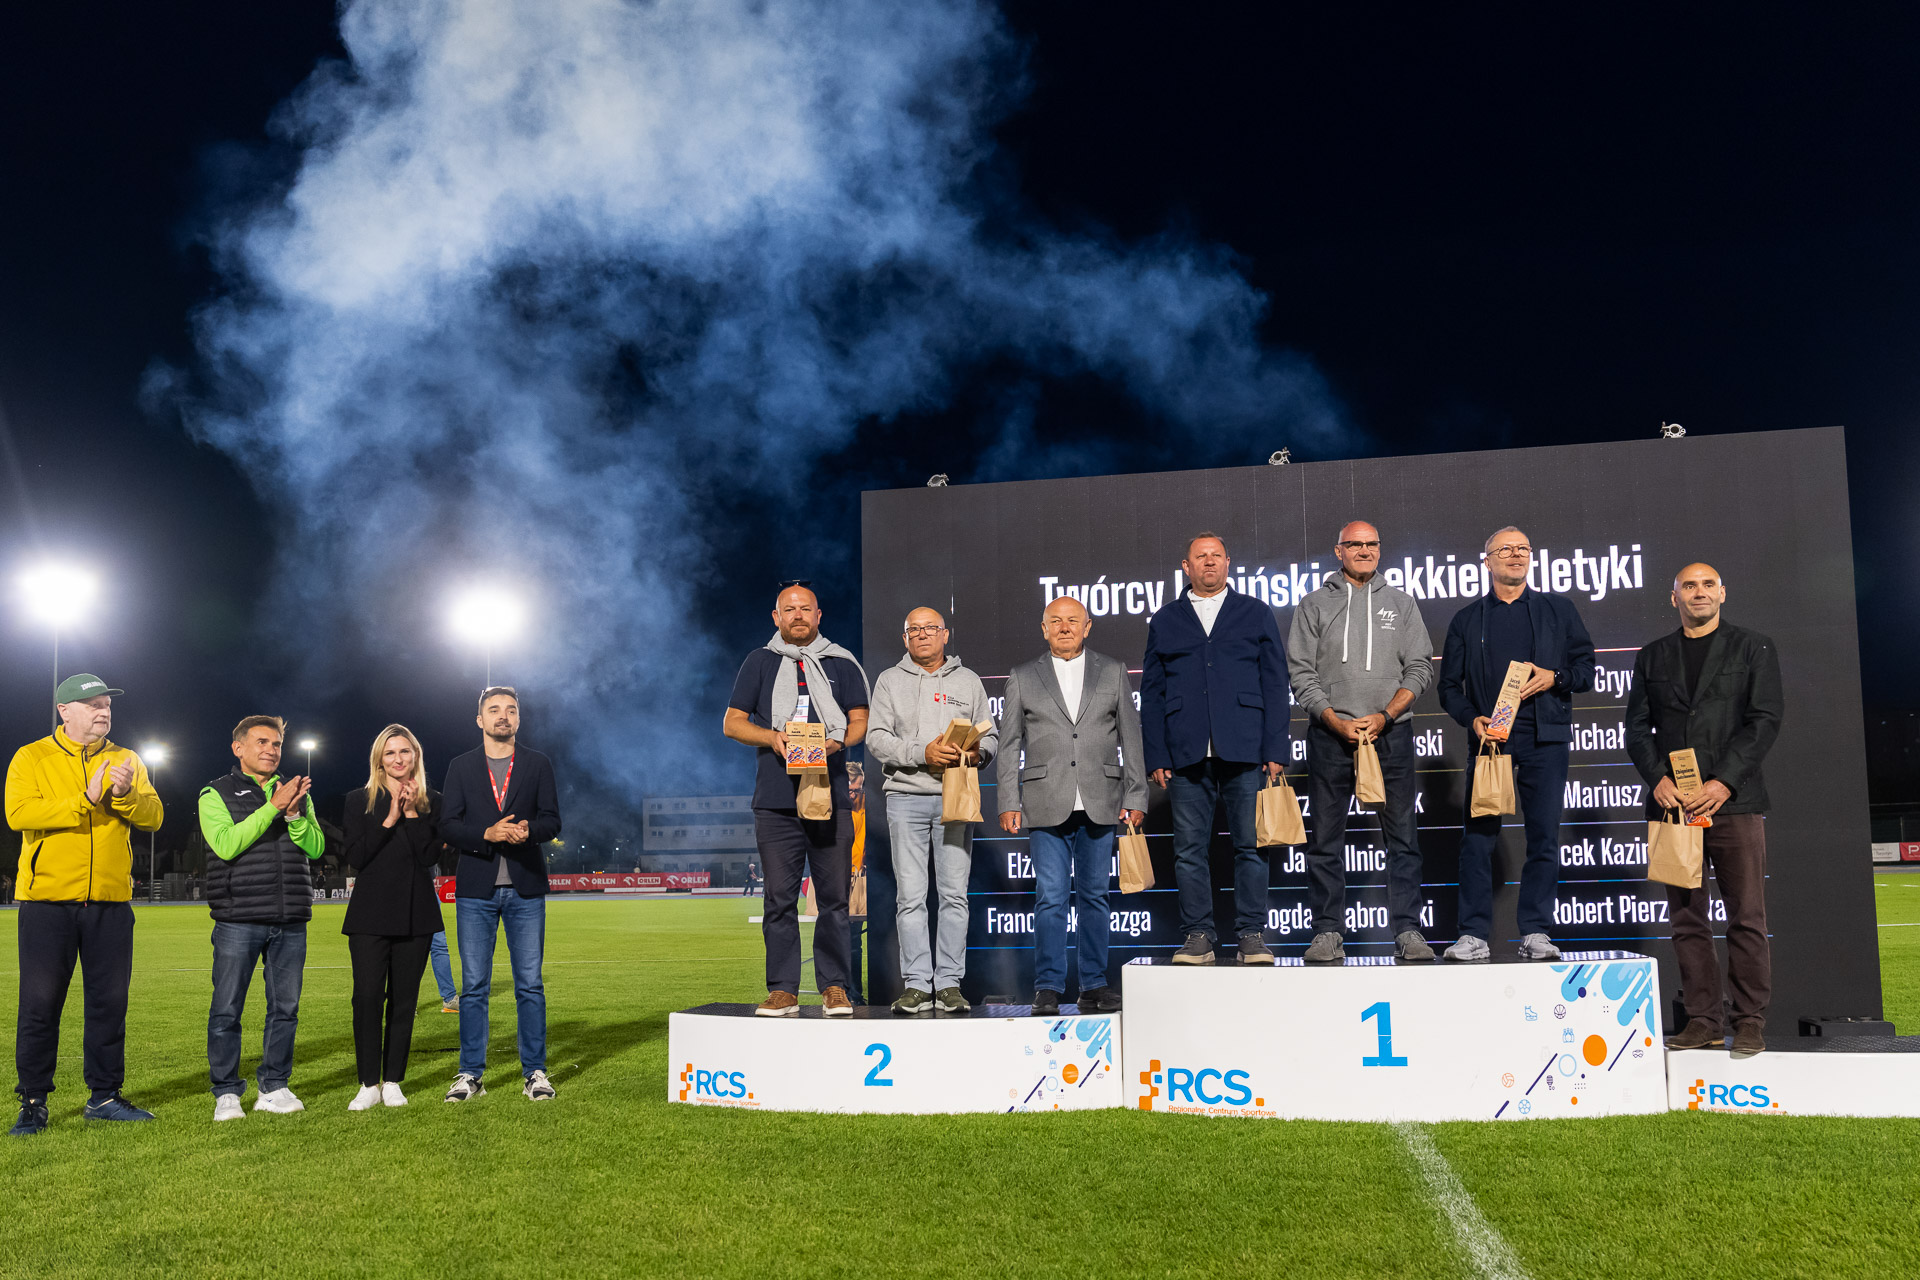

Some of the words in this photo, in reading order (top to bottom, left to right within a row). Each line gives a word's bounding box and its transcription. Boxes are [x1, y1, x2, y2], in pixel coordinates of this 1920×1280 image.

[1384, 553, 1491, 600] ekkiej
[1526, 543, 1643, 602] tletyki
[1563, 779, 1643, 809] Mariusz
[1283, 846, 1308, 873] Ja
[1560, 838, 1596, 866] cek
[591, 877, 616, 885] ORLEN
[638, 877, 661, 885] ORLEN
[680, 876, 709, 884] ORLEN
[1109, 911, 1151, 937] azga
[1263, 902, 1313, 935] ogda
[1361, 1001, 1408, 1067] 1
[864, 1043, 893, 1087] 2
[1168, 1105, 1206, 1114] Regionalne
[1208, 1107, 1239, 1115] Centrum
[1240, 1108, 1277, 1116] Sportowe
